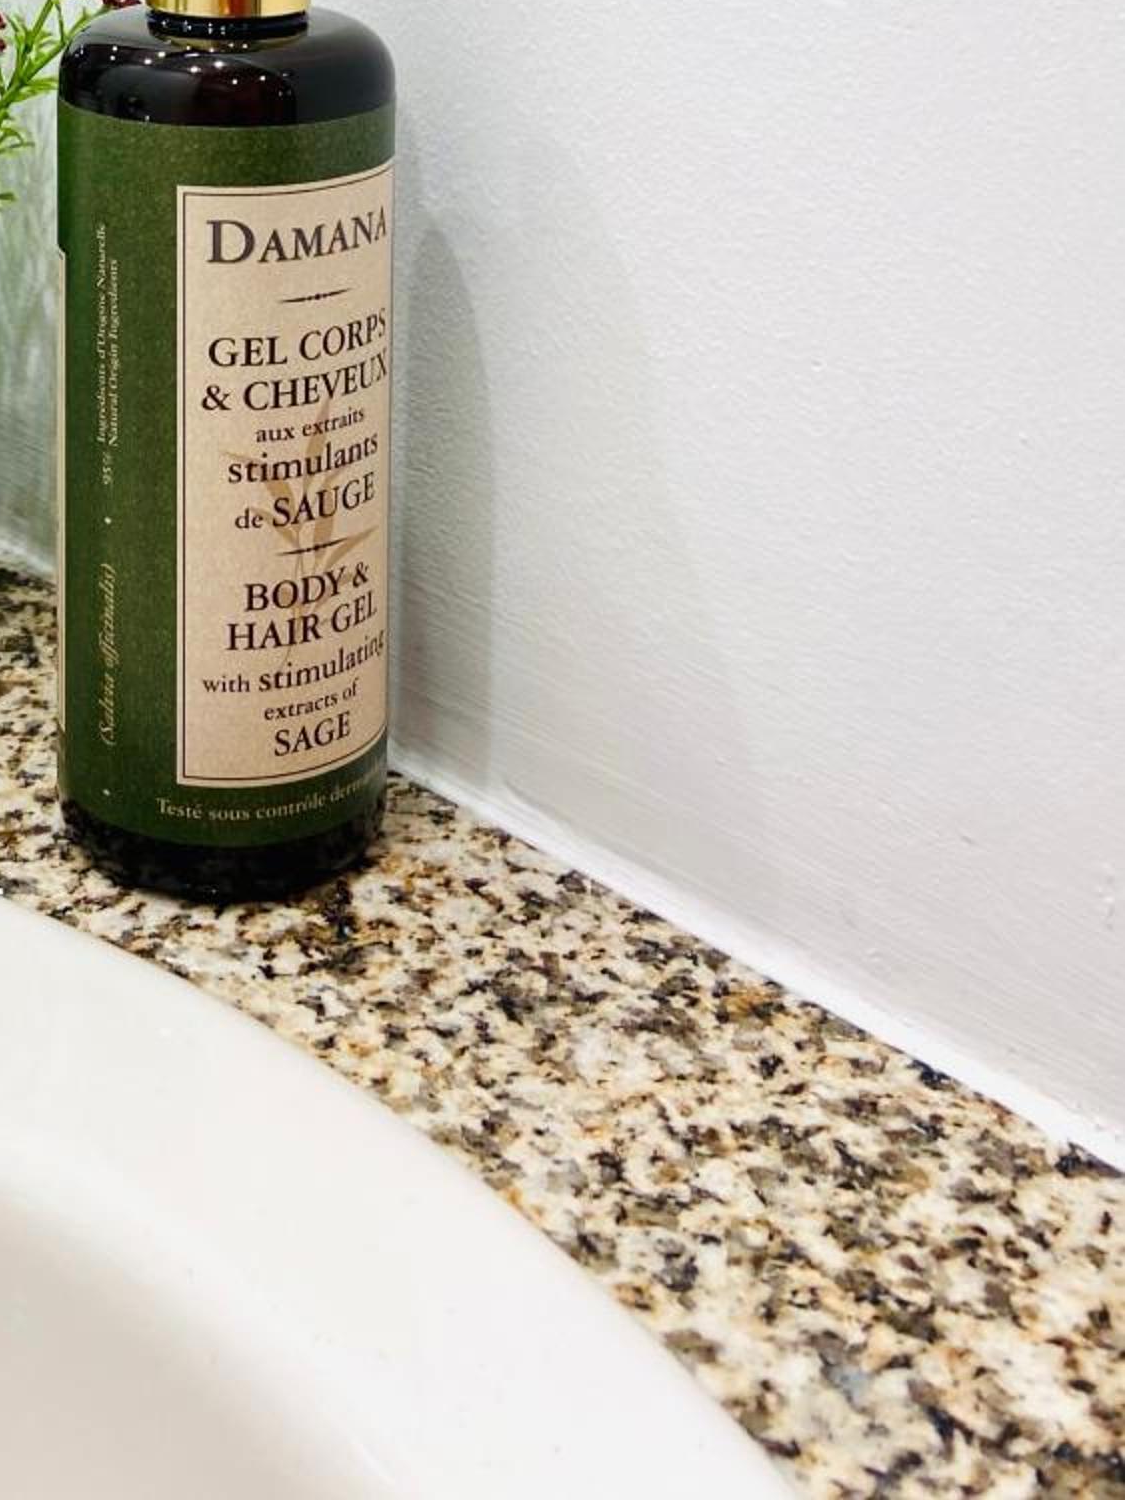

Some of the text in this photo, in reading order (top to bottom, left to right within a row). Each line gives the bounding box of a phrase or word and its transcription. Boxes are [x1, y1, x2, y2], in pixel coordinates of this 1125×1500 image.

[107, 259, 120, 447] Natural Origin Ingredients
[207, 307, 386, 367] GEL CORPS
[201, 348, 387, 411] & CHEVEUX
[255, 406, 365, 443] aux extraits
[228, 432, 378, 484] stimulants
[235, 471, 375, 529] de SAUGE
[244, 561, 370, 612] BODY &
[226, 588, 378, 651] HAIR GEL
[202, 629, 385, 693] with stimulating
[263, 677, 360, 721] extracts of
[274, 711, 352, 757] SAGE
[156, 797, 203, 820] Testé
[208, 810, 251, 822] sous
[256, 793, 326, 819] contrôle
